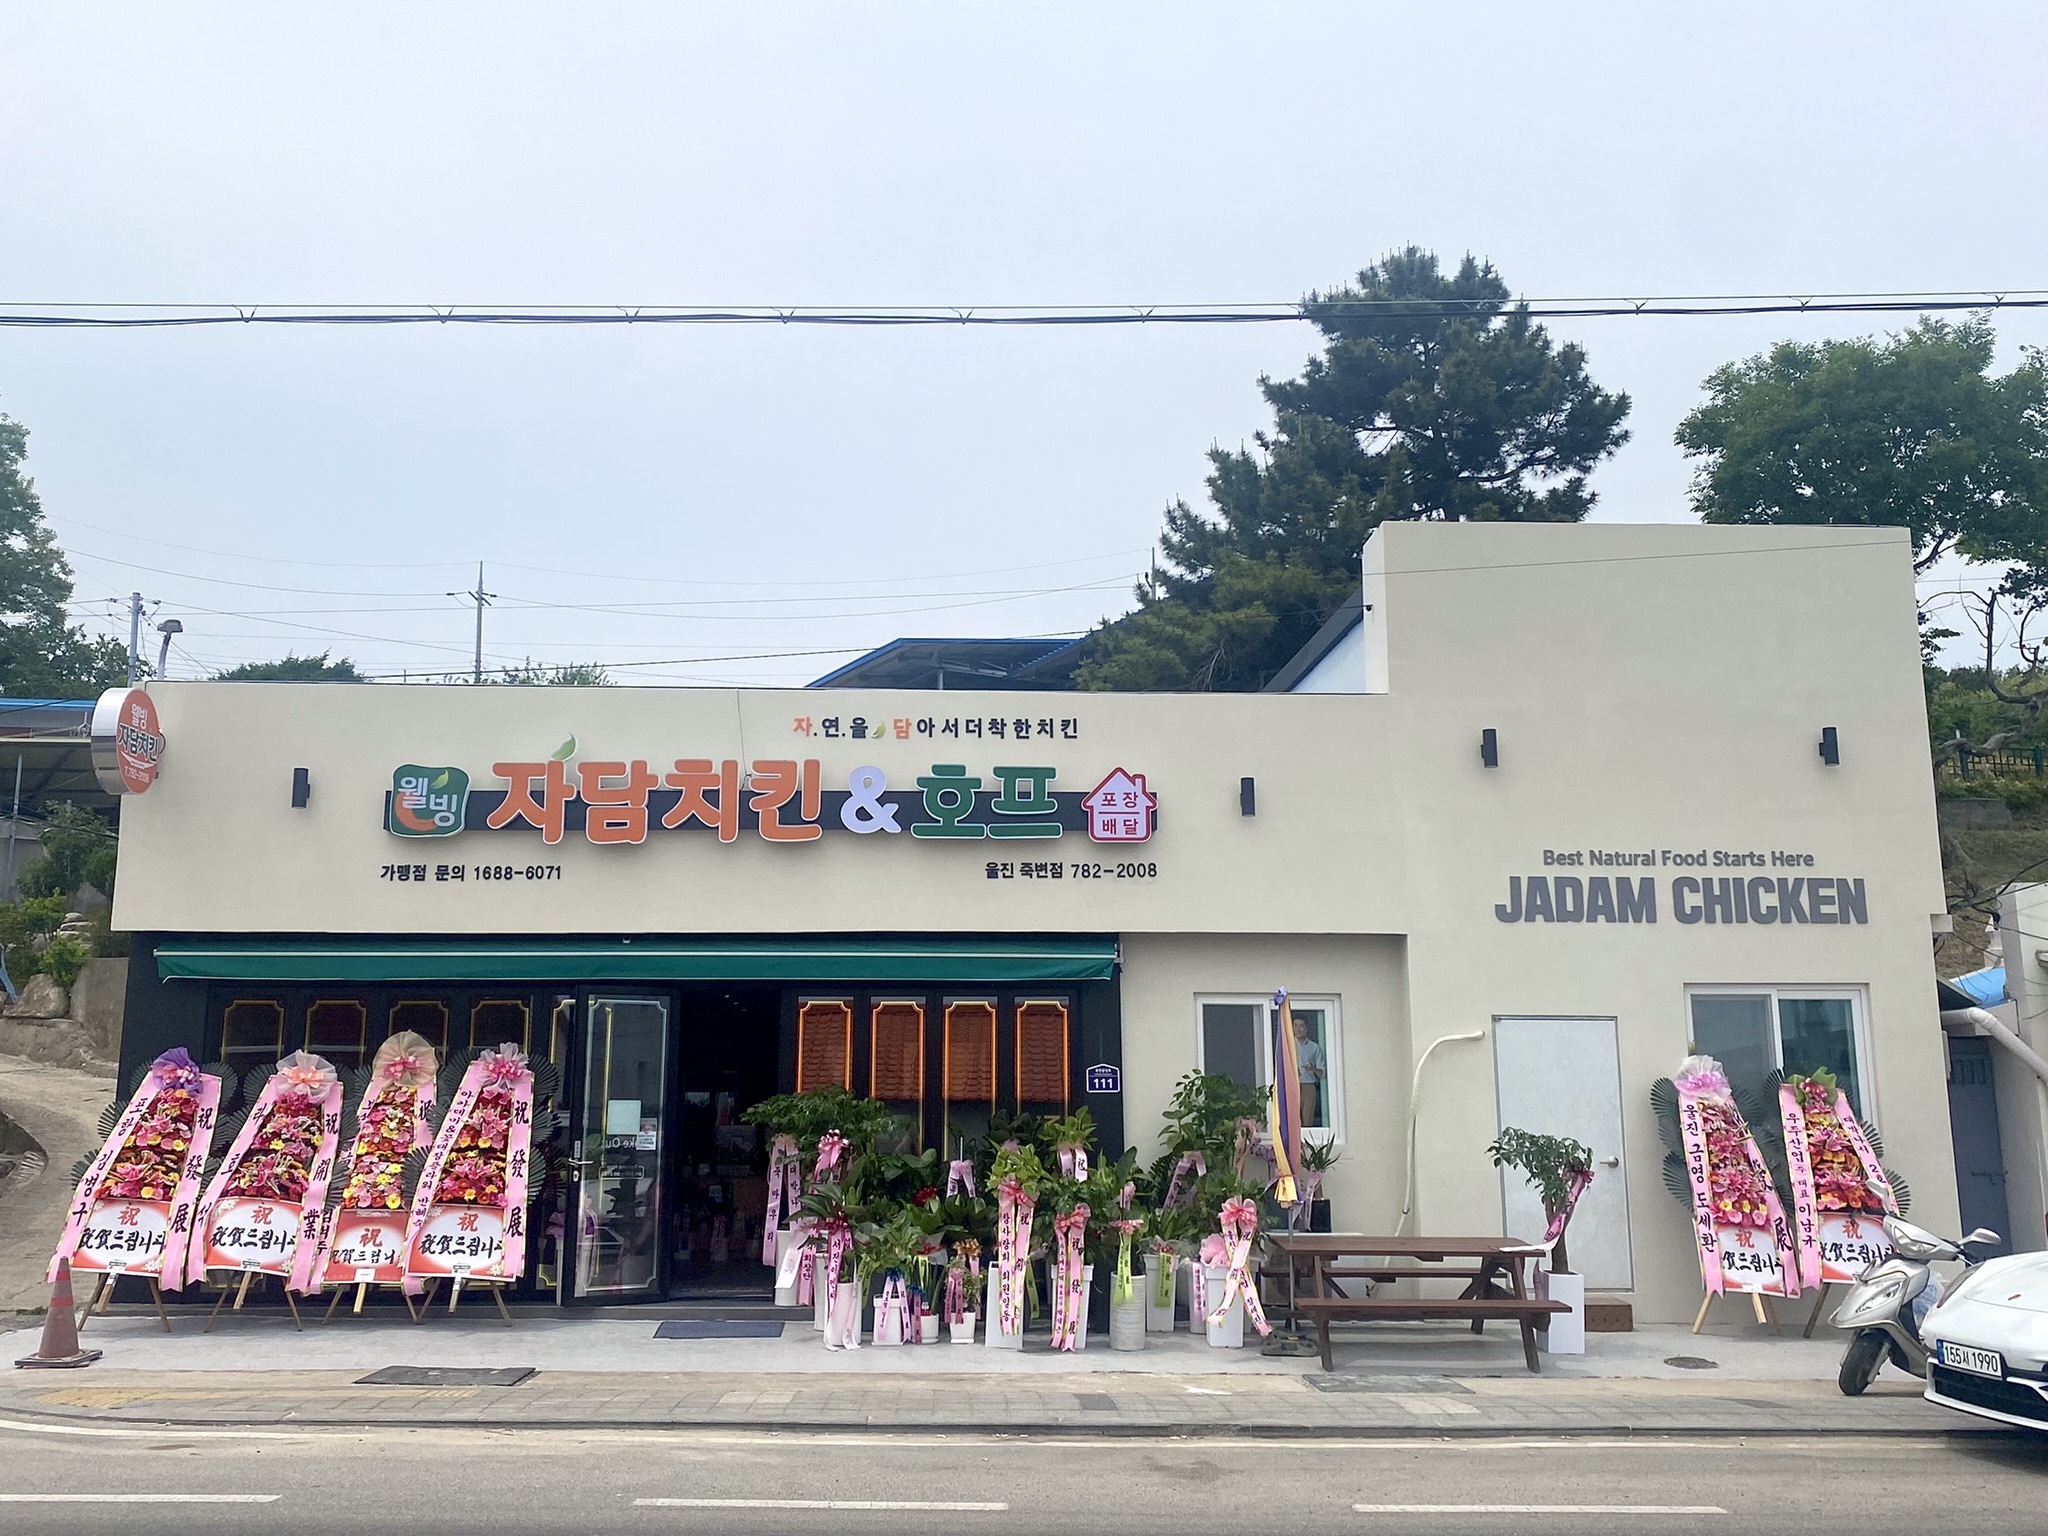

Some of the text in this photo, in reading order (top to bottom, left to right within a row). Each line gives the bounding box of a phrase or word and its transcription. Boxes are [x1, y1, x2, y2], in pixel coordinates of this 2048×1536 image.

[131, 703, 148, 729] 웰빙
[118, 722, 159, 764] 자담치킨
[398, 759, 1063, 845] 웰빙 자담치킨 & 호프
[1101, 791, 1139, 808] 포장
[1102, 818, 1139, 836] 배달
[1543, 849, 1815, 867] Best Natural Food Starts Here
[381, 865, 562, 882] 가맹점 문의 1688-6071
[985, 863, 1157, 880] 울진 죽변점 782-2008
[1495, 876, 1869, 925] JADAM CHICKEN
[1093, 1078, 1113, 1089] 111
[1683, 1104, 1699, 1136] 울진
[118, 1206, 141, 1227] 祝
[250, 1205, 272, 1226] 祝
[457, 1212, 479, 1233] 祝
[359, 1228, 383, 1247] 祝
[1735, 1229, 1754, 1249] 祝
[1842, 1220, 1863, 1240] 祝
